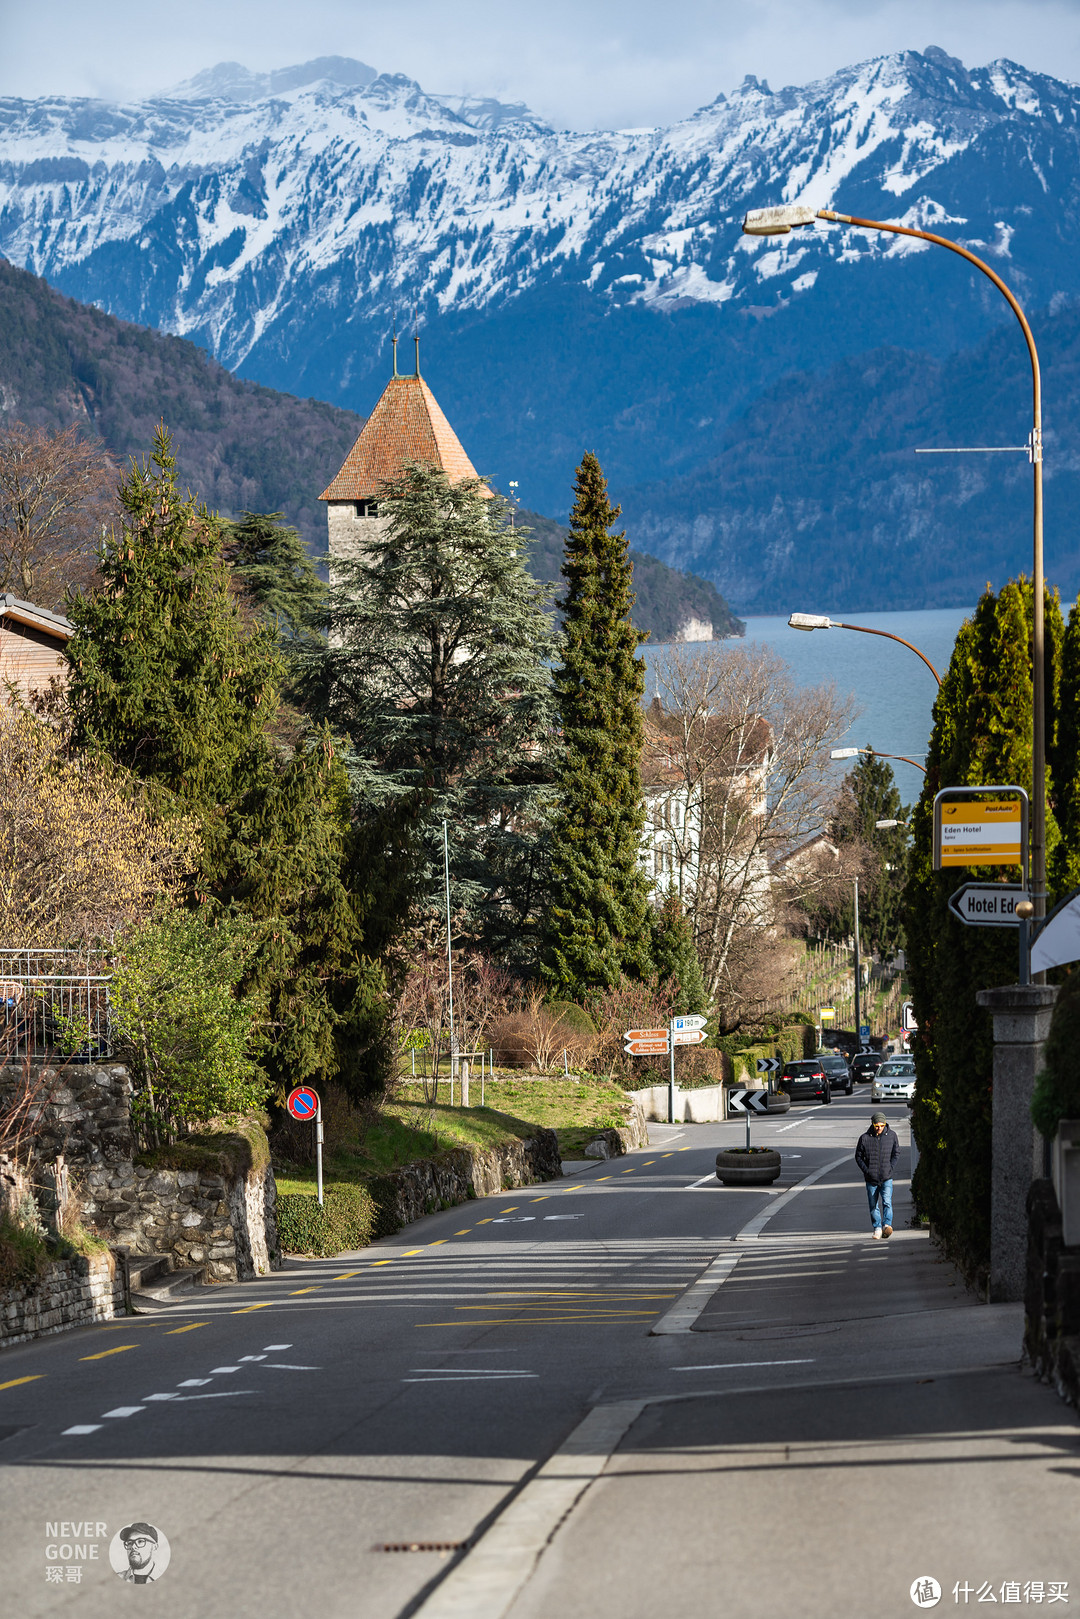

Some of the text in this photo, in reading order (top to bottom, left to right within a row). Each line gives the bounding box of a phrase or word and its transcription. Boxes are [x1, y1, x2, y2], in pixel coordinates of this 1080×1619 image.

[968, 896, 1018, 914] Hotel Ed
[685, 1019, 693, 1027] 190
